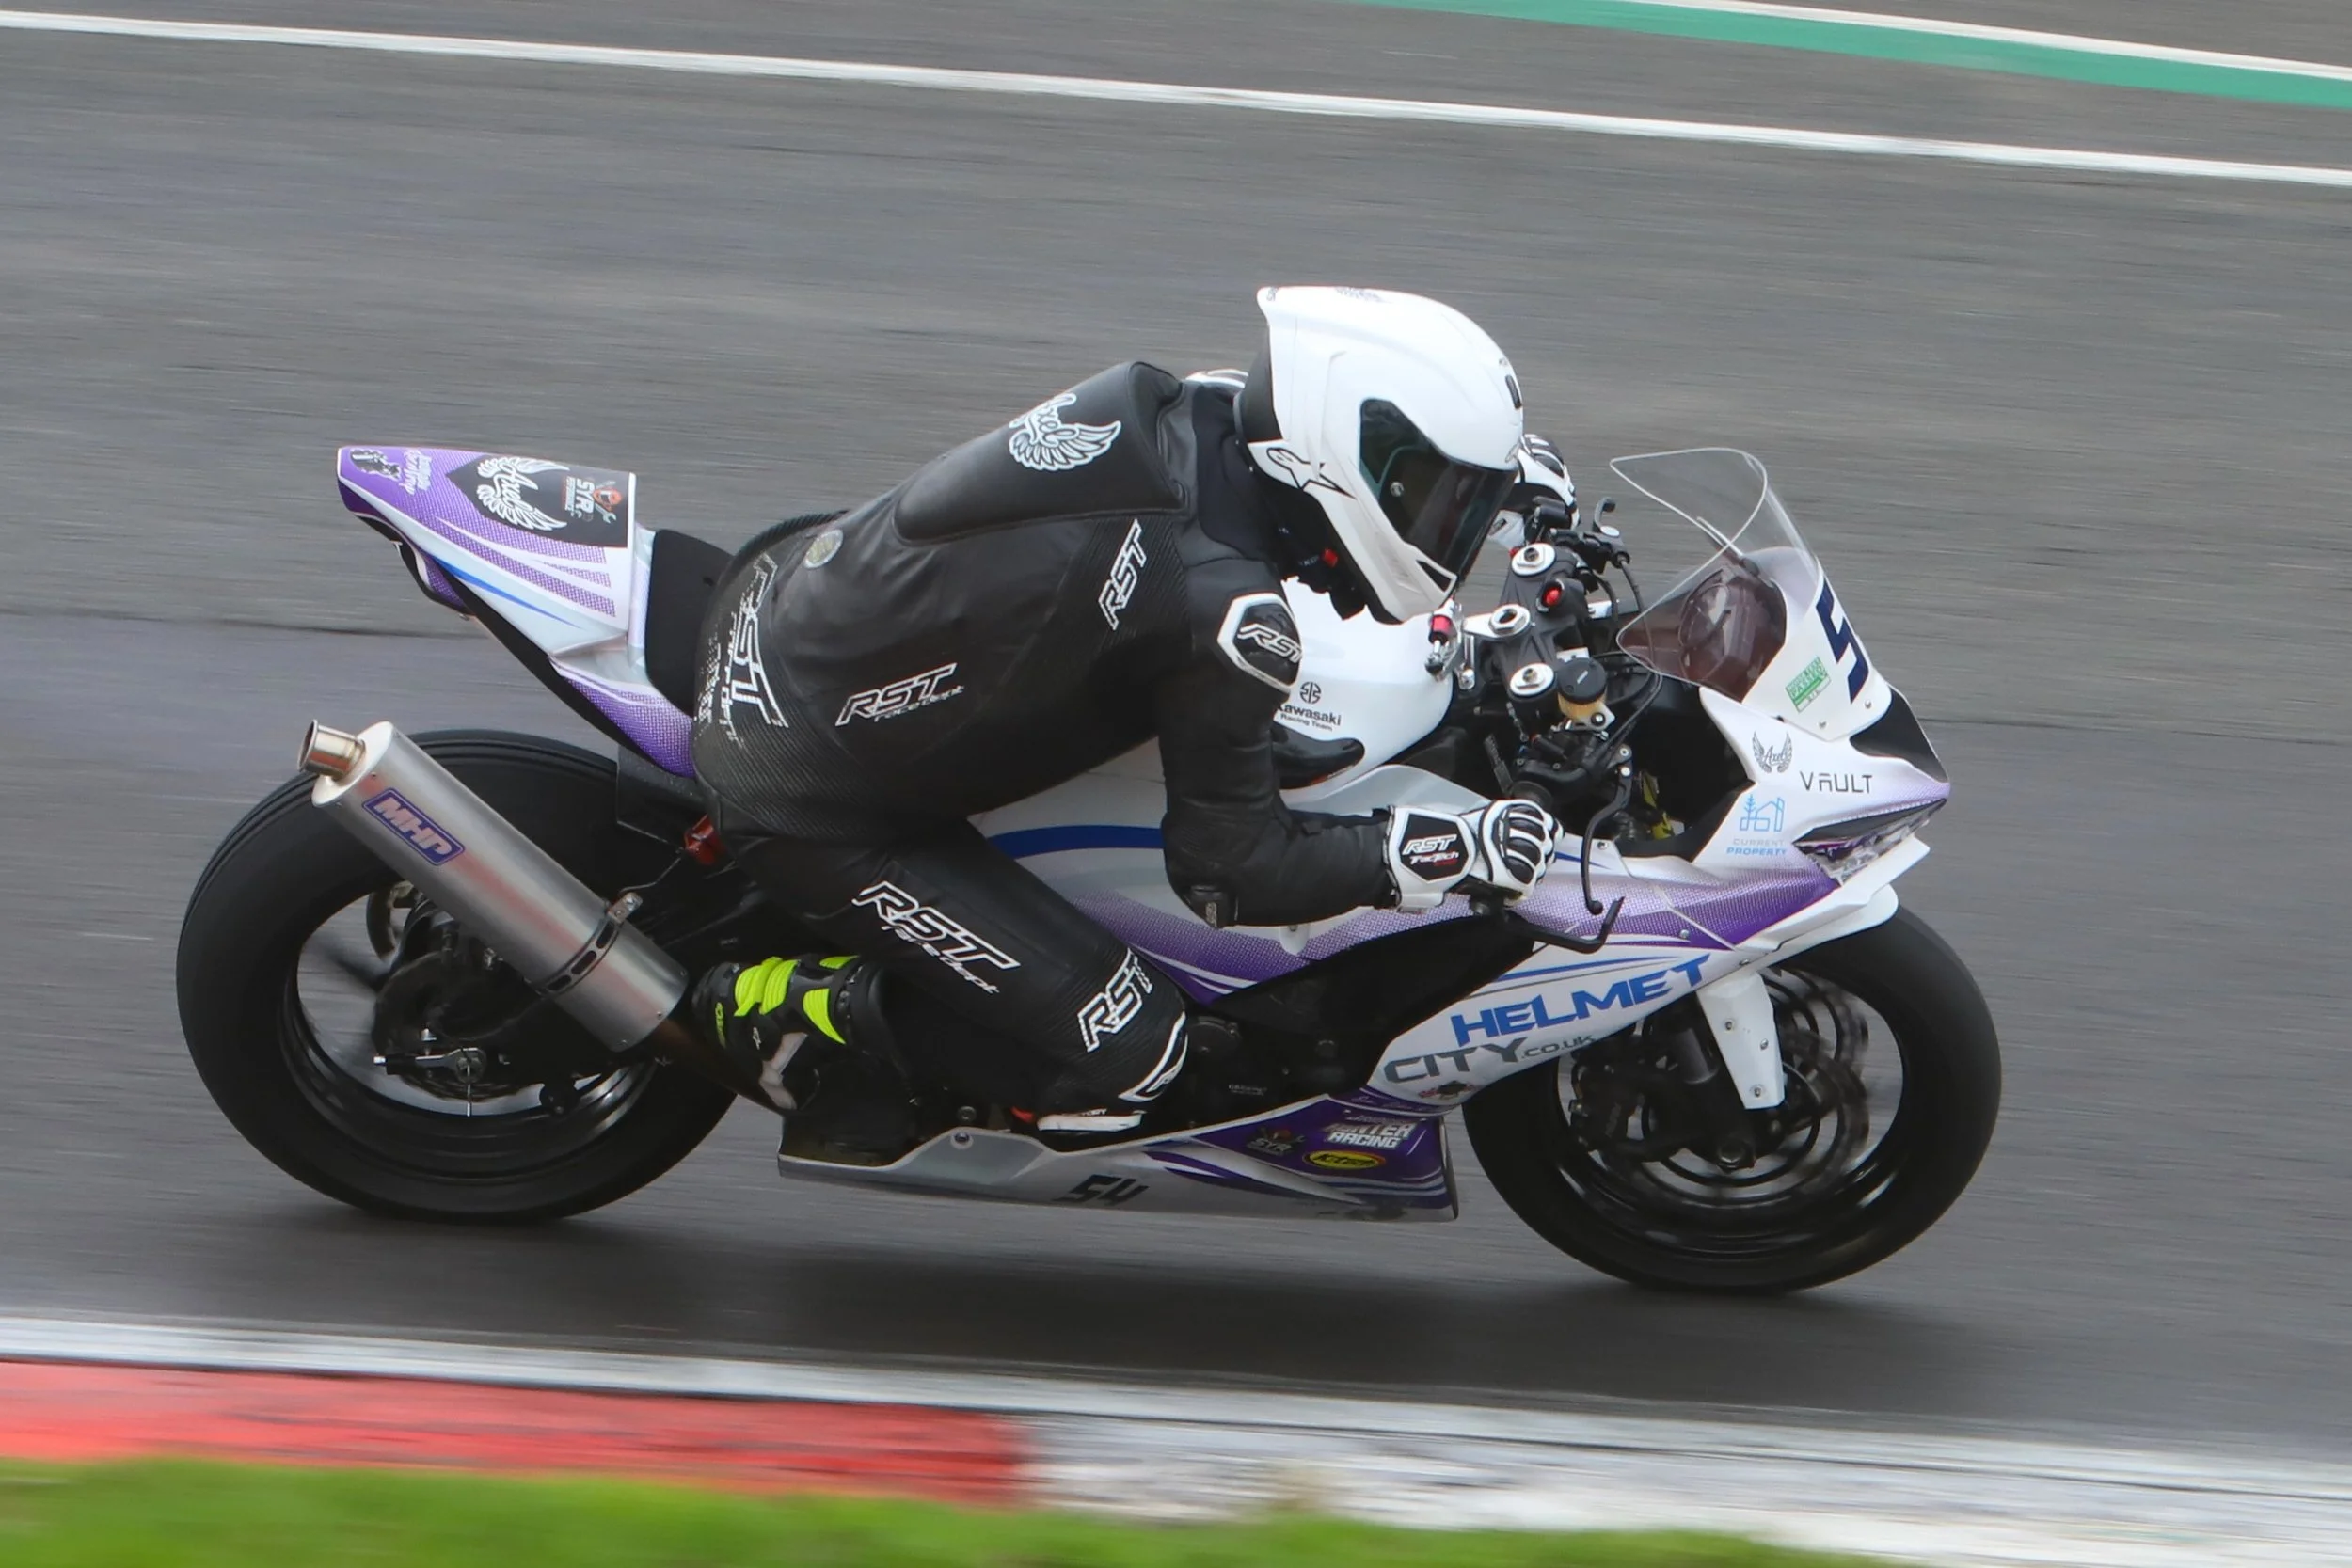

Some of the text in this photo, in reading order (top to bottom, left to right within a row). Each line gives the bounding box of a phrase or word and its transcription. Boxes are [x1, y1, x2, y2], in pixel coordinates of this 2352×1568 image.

[576, 478, 596, 514] SYR
[1098, 518, 1147, 630] RST
[731, 552, 789, 728] RST
[835, 662, 958, 726] RST
[1280, 714, 1333, 732] Racing Team
[1799, 771, 1873, 794] VAULT
[373, 797, 453, 855] MHP
[1402, 833, 1458, 855] RST
[1733, 837, 1785, 846] CURRENT
[851, 880, 1021, 970] RST
[939, 955, 1000, 994] dept
[1077, 947, 1153, 1053] RST
[1450, 953, 1711, 1048] HELMET
[1327, 1132, 1402, 1148] RACING
[1051, 1174, 1150, 1206] 54
